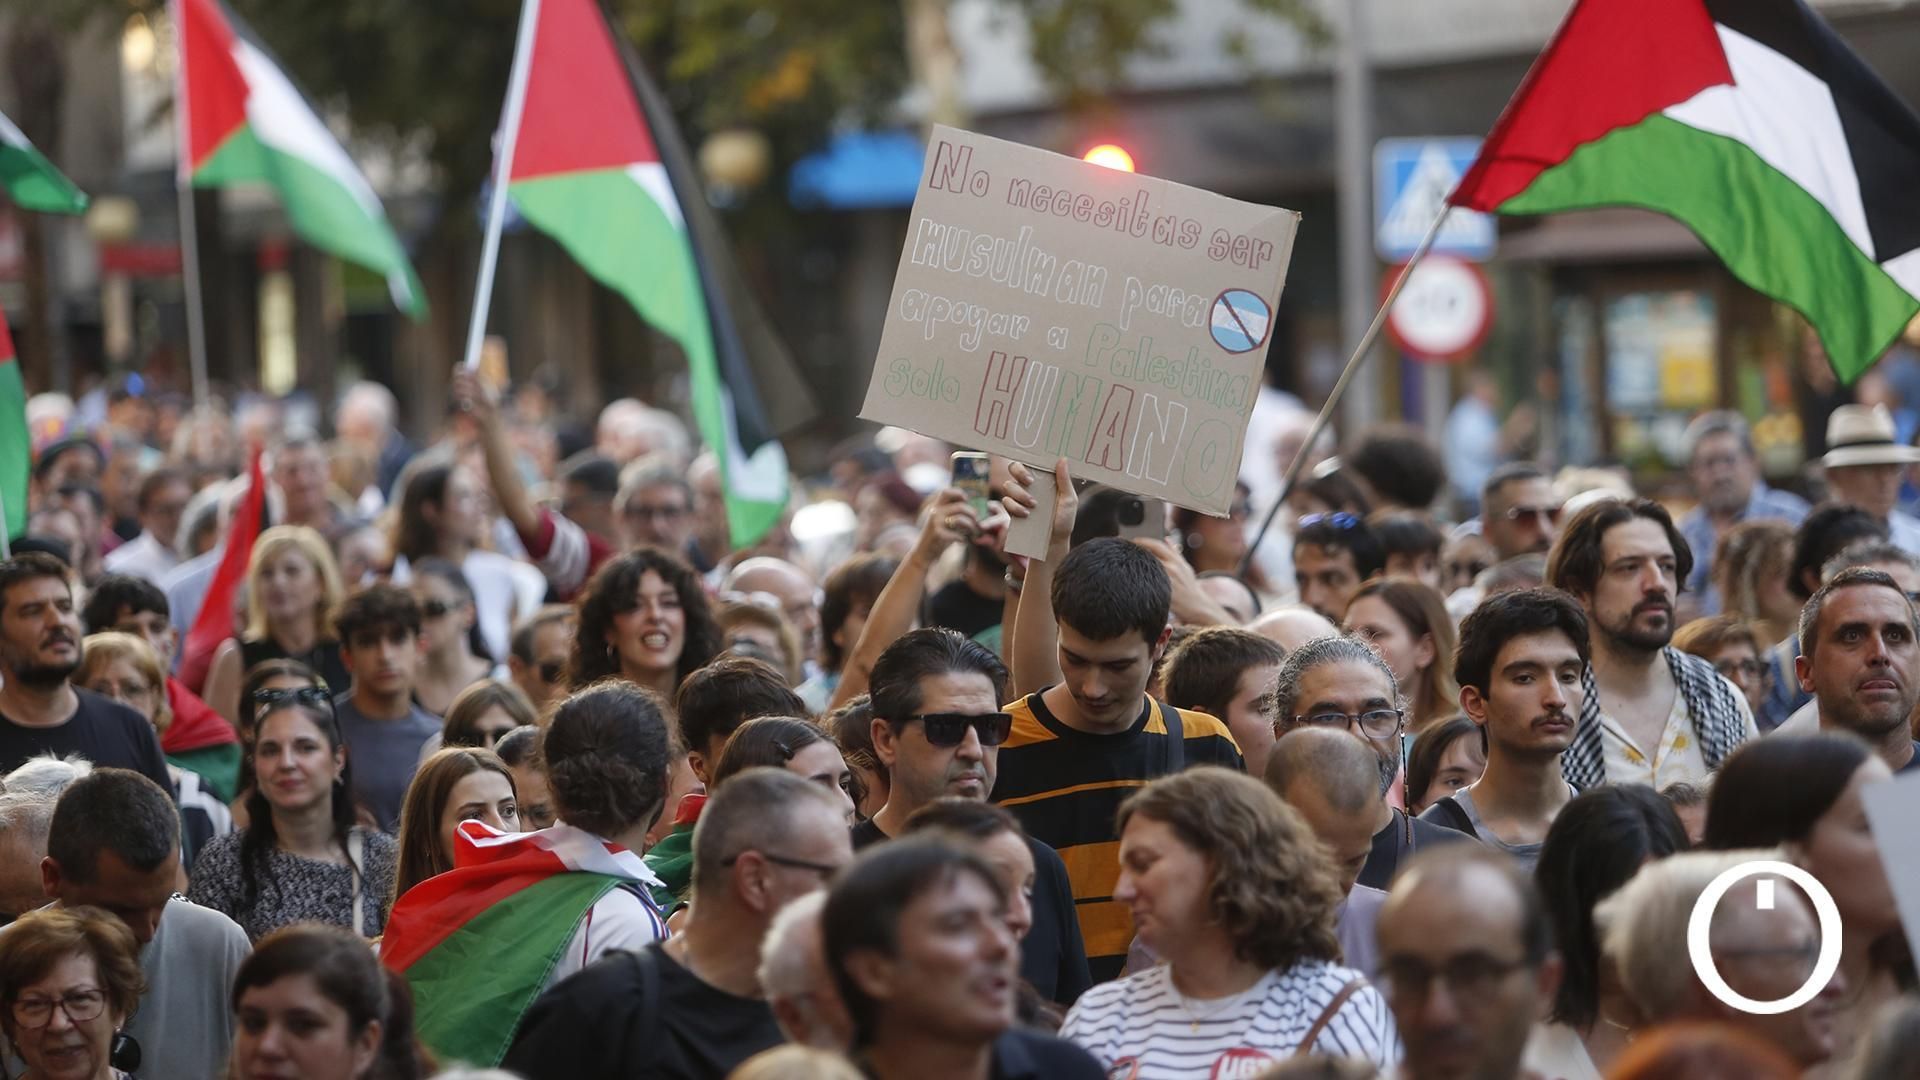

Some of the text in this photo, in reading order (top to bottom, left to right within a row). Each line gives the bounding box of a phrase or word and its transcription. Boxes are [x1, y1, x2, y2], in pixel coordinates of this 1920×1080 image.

[929, 140, 1274, 269] No necesitas ser
[900, 289, 1031, 352] apoyar
[1047, 326, 1069, 350] a
[1120, 276, 1209, 330] para
[974, 350, 1232, 498] HUMANO
